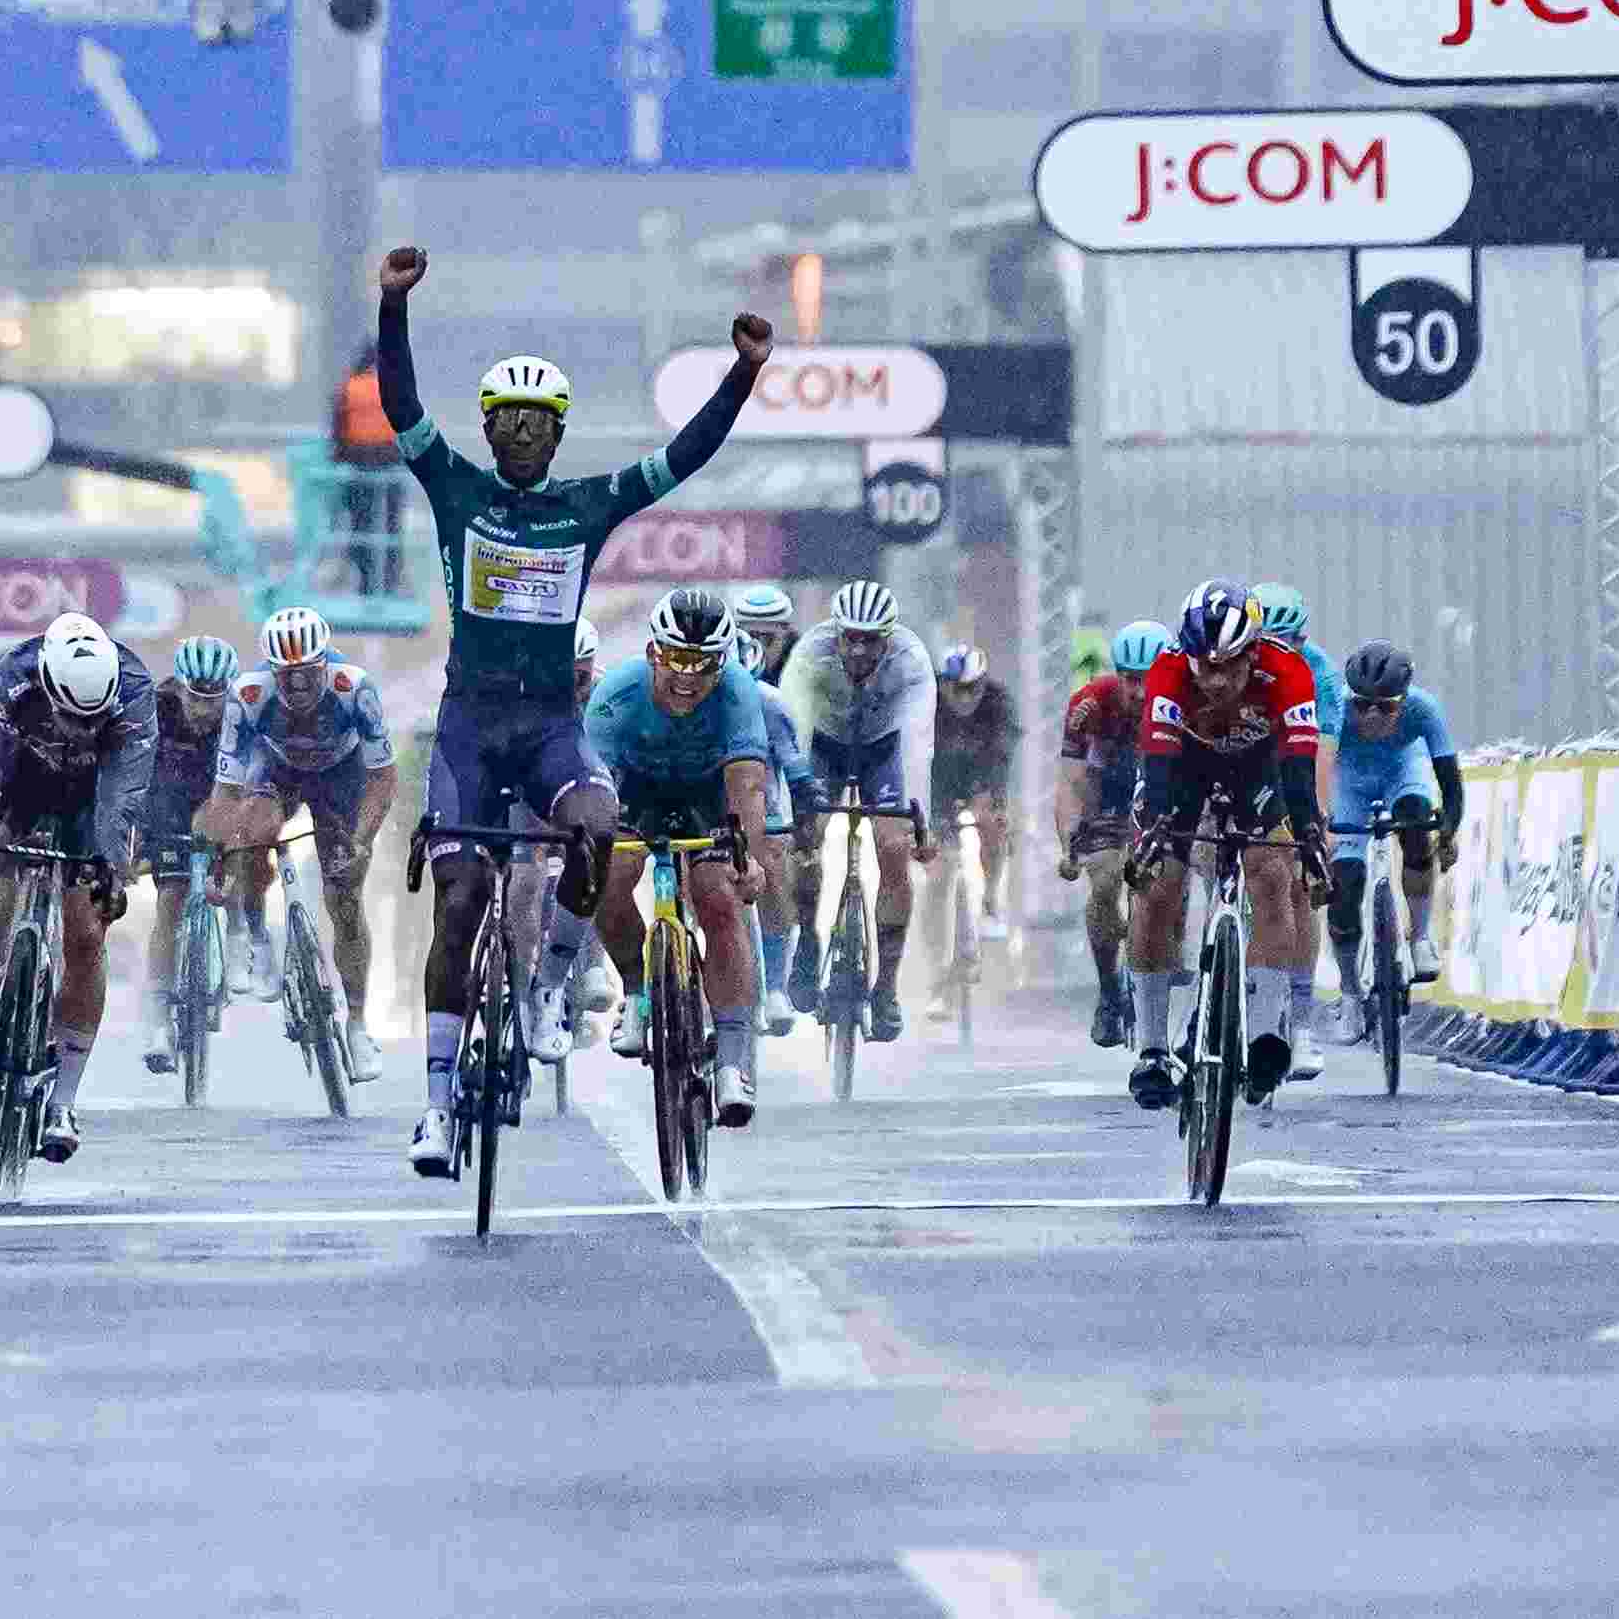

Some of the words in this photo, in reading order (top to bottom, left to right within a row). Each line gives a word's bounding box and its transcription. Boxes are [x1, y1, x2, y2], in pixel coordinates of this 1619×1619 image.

[1125, 137, 1389, 223] J:COM
[1375, 310, 1460, 375] 50
[757, 364, 889, 410] COM
